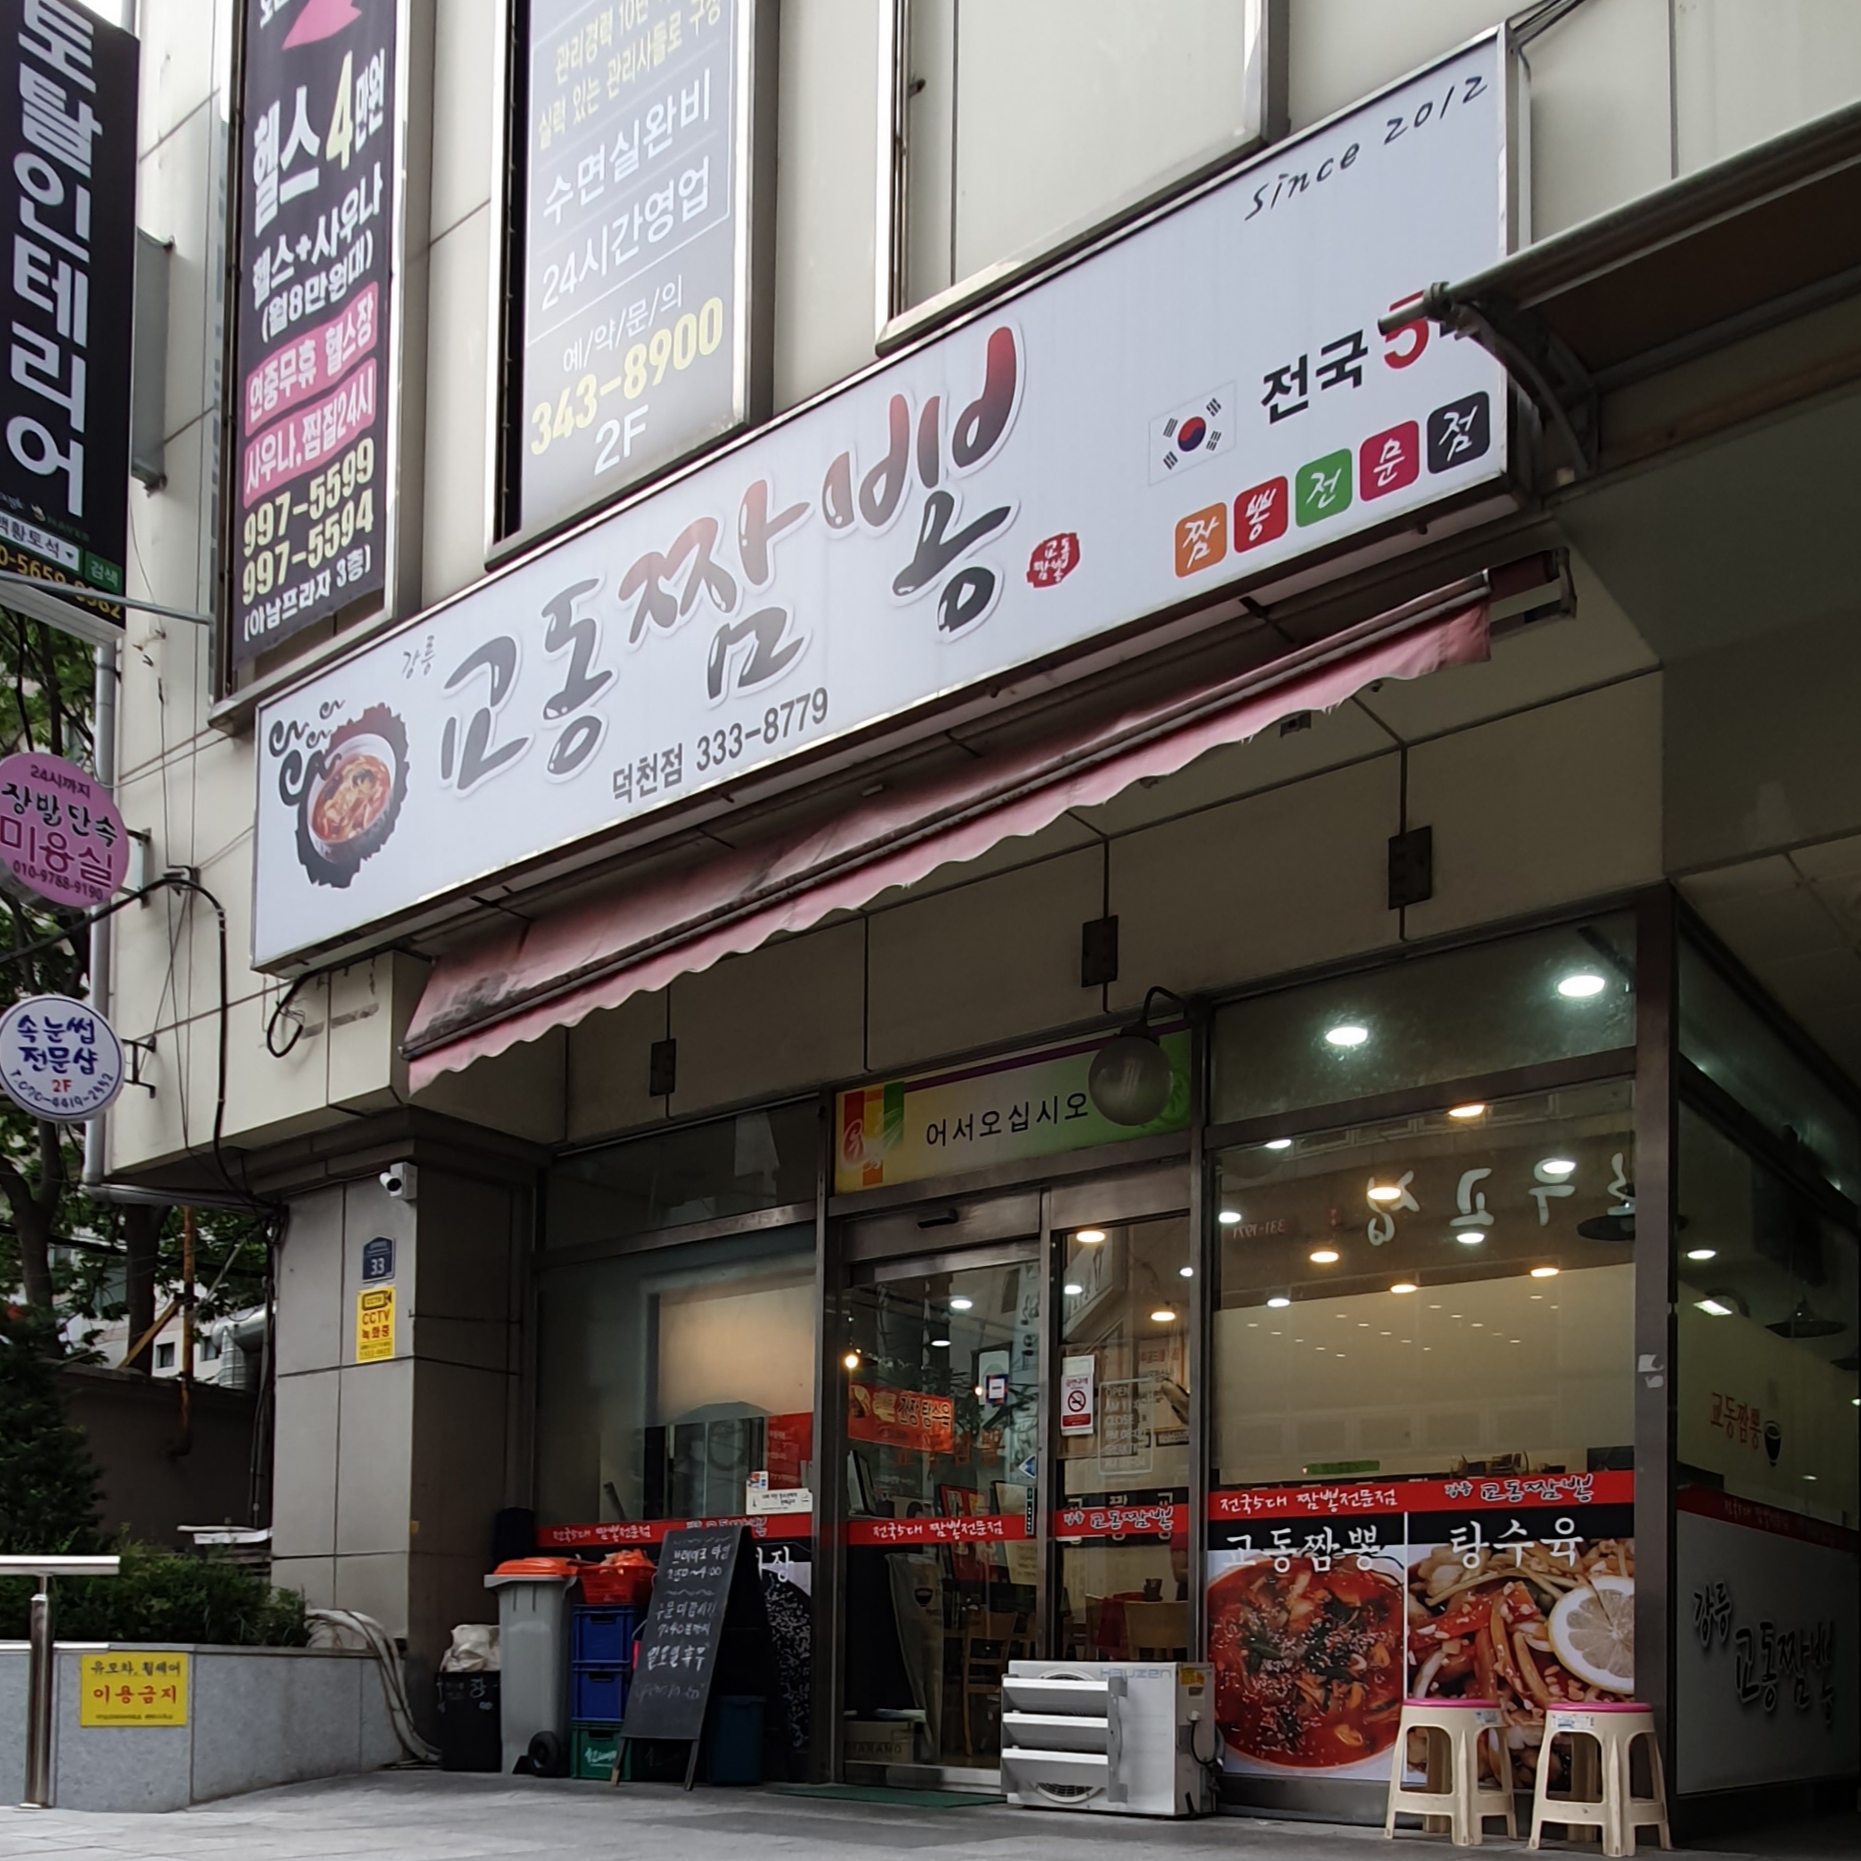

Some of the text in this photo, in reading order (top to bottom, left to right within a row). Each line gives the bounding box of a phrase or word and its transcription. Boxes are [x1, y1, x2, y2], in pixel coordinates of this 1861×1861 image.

[1384, 75, 1489, 146] 2012
[543, 67, 710, 225] 수면실완비
[541, 155, 710, 312] 24시간영업
[562, 273, 683, 373] 예/약/문/의
[1260, 289, 1462, 425] 전국5
[530, 296, 723, 456] 343-8900
[593, 403, 649, 476] 2F
[243, 436, 375, 558] 997-5599
[242, 487, 374, 606] 997-5594
[612, 686, 829, 804] 덕천점 333-8779
[2, 782, 118, 849] 장발단속
[0, 814, 112, 889] 미용실
[17, 1014, 96, 1045] 속눈썹
[52, 1079, 72, 1093] 2F
[925, 1090, 1090, 1148] 어서오십시오
[370, 1257, 386, 1276] 33
[362, 1308, 391, 1326] CCTV
[1295, 1487, 1399, 1513] 짬뽕전문점
[1480, 1473, 1595, 1503] 교동짬뽕
[1220, 1524, 1382, 1574] 교동짬뽕
[1449, 1516, 1585, 1570] 탕수육
[93, 1684, 177, 1705] 이용금지
